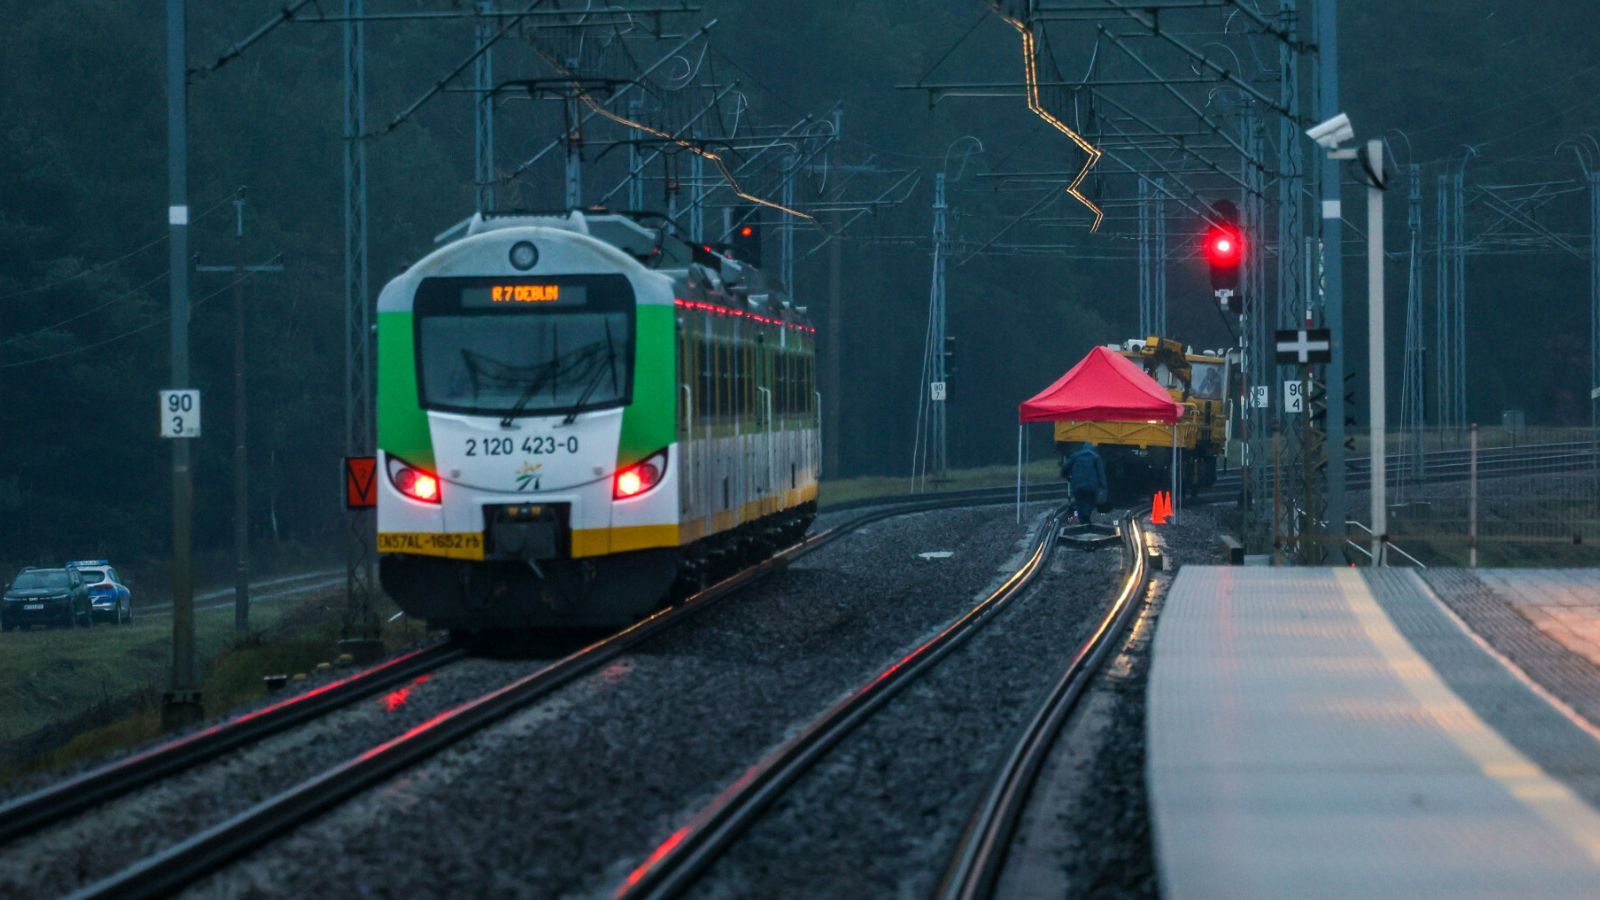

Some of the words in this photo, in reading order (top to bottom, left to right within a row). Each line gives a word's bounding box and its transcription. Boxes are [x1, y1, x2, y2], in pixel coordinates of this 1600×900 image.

[169, 394, 192, 412] 90
[1292, 398, 1300, 411] 4
[172, 416, 183, 434] 3
[465, 438, 476, 456] 2
[483, 437, 513, 455] 120
[521, 436, 578, 454] 423-0
